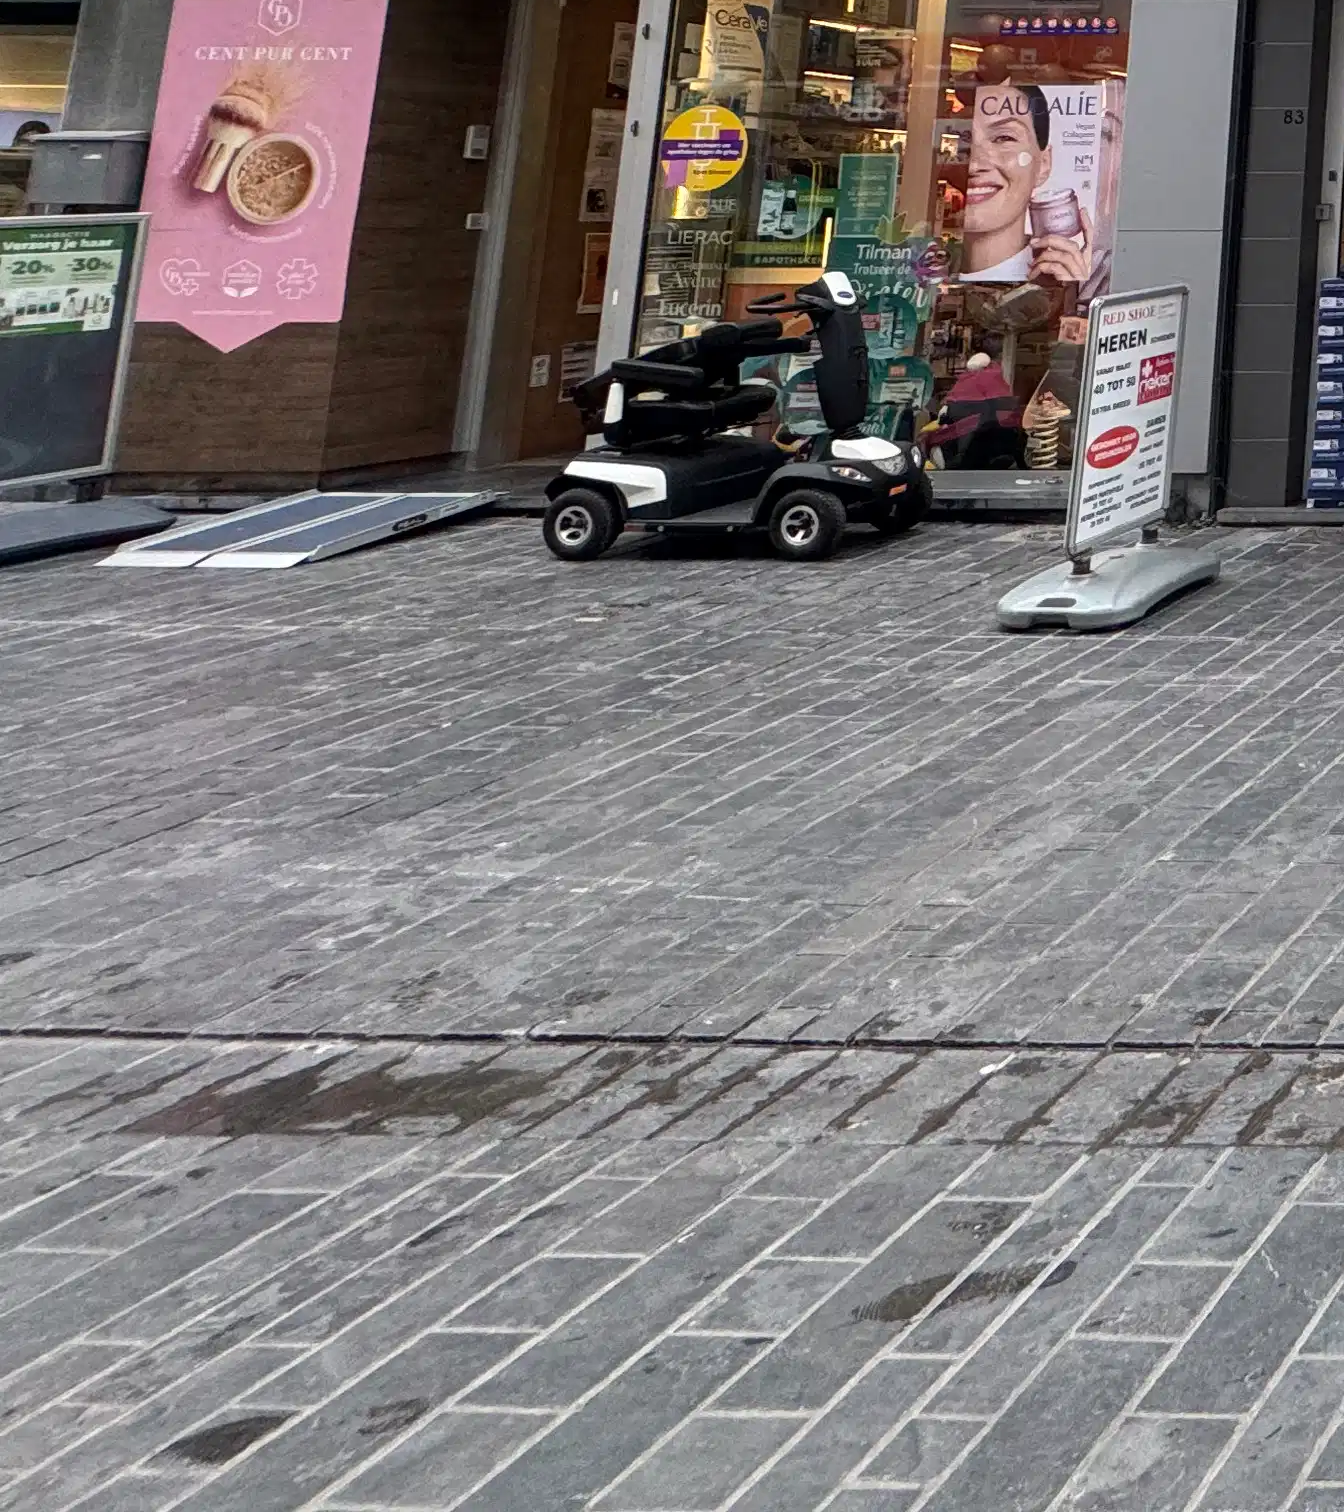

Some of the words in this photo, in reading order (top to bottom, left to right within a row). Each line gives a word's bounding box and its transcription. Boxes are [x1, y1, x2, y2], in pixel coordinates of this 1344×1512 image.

[715, 9, 769, 32] CeraVe
[195, 46, 248, 61] CENT
[252, 46, 293, 61] PUR
[300, 46, 352, 61] CENT
[1282, 109, 1304, 125] 83
[2, 241, 62, 251] Verzorg
[63, 239, 78, 251] je
[80, 239, 114, 248] haar
[667, 230, 734, 245] LIERAC
[857, 243, 912, 260] Tilman
[853, 262, 896, 275] Trotseer
[898, 262, 911, 275] de
[1102, 311, 1126, 326] RED
[1127, 305, 1158, 322] SHOE
[1097, 328, 1148, 355] HEREN
[1107, 378, 1124, 392] TOT
